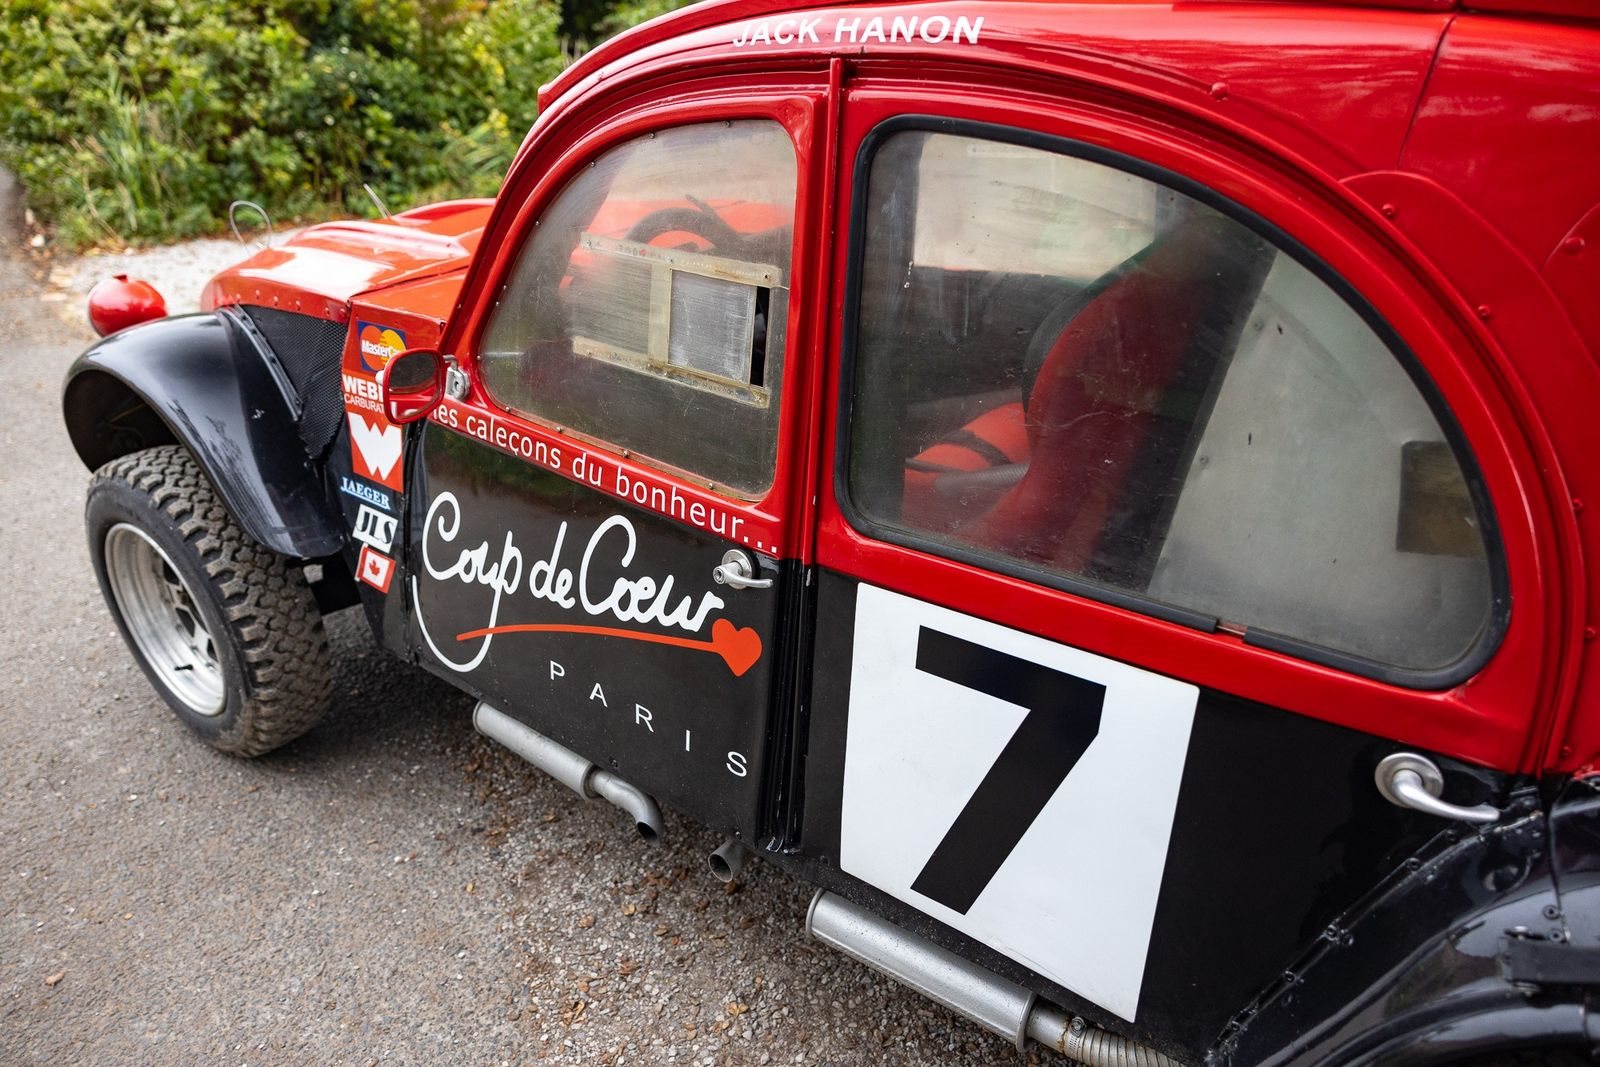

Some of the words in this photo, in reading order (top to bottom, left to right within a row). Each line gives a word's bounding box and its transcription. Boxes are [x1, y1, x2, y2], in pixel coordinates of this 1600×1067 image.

[732, 17, 823, 48] JACK
[833, 16, 985, 45] HANON
[466, 416, 561, 469] caleçons
[572, 452, 602, 486] du
[340, 476, 391, 510] JAEGER
[412, 491, 523, 673] Coup
[529, 520, 576, 609] de
[909, 624, 1107, 916] 7
